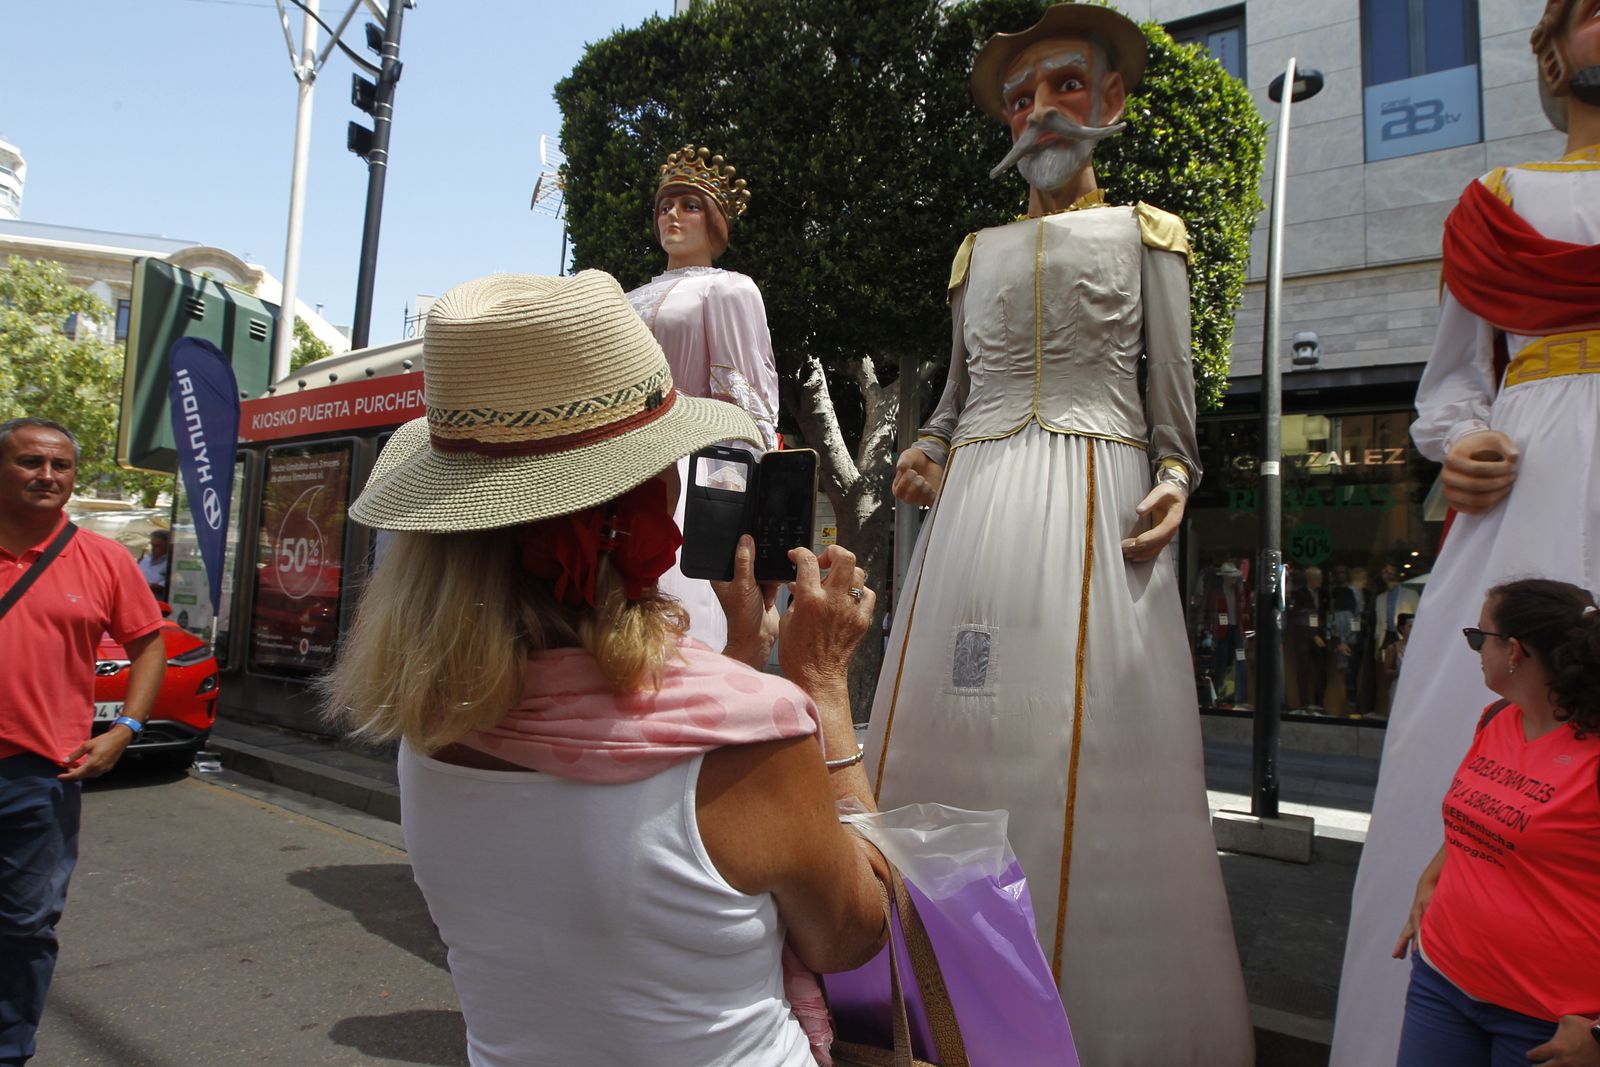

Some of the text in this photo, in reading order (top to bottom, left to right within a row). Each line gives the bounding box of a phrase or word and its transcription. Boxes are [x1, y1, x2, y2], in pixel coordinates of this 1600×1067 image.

[252, 408, 297, 430] KIOSKO
[300, 400, 350, 423] PUERTA
[280, 537, 320, 573] 50%
[1292, 535, 1330, 558] 50%
